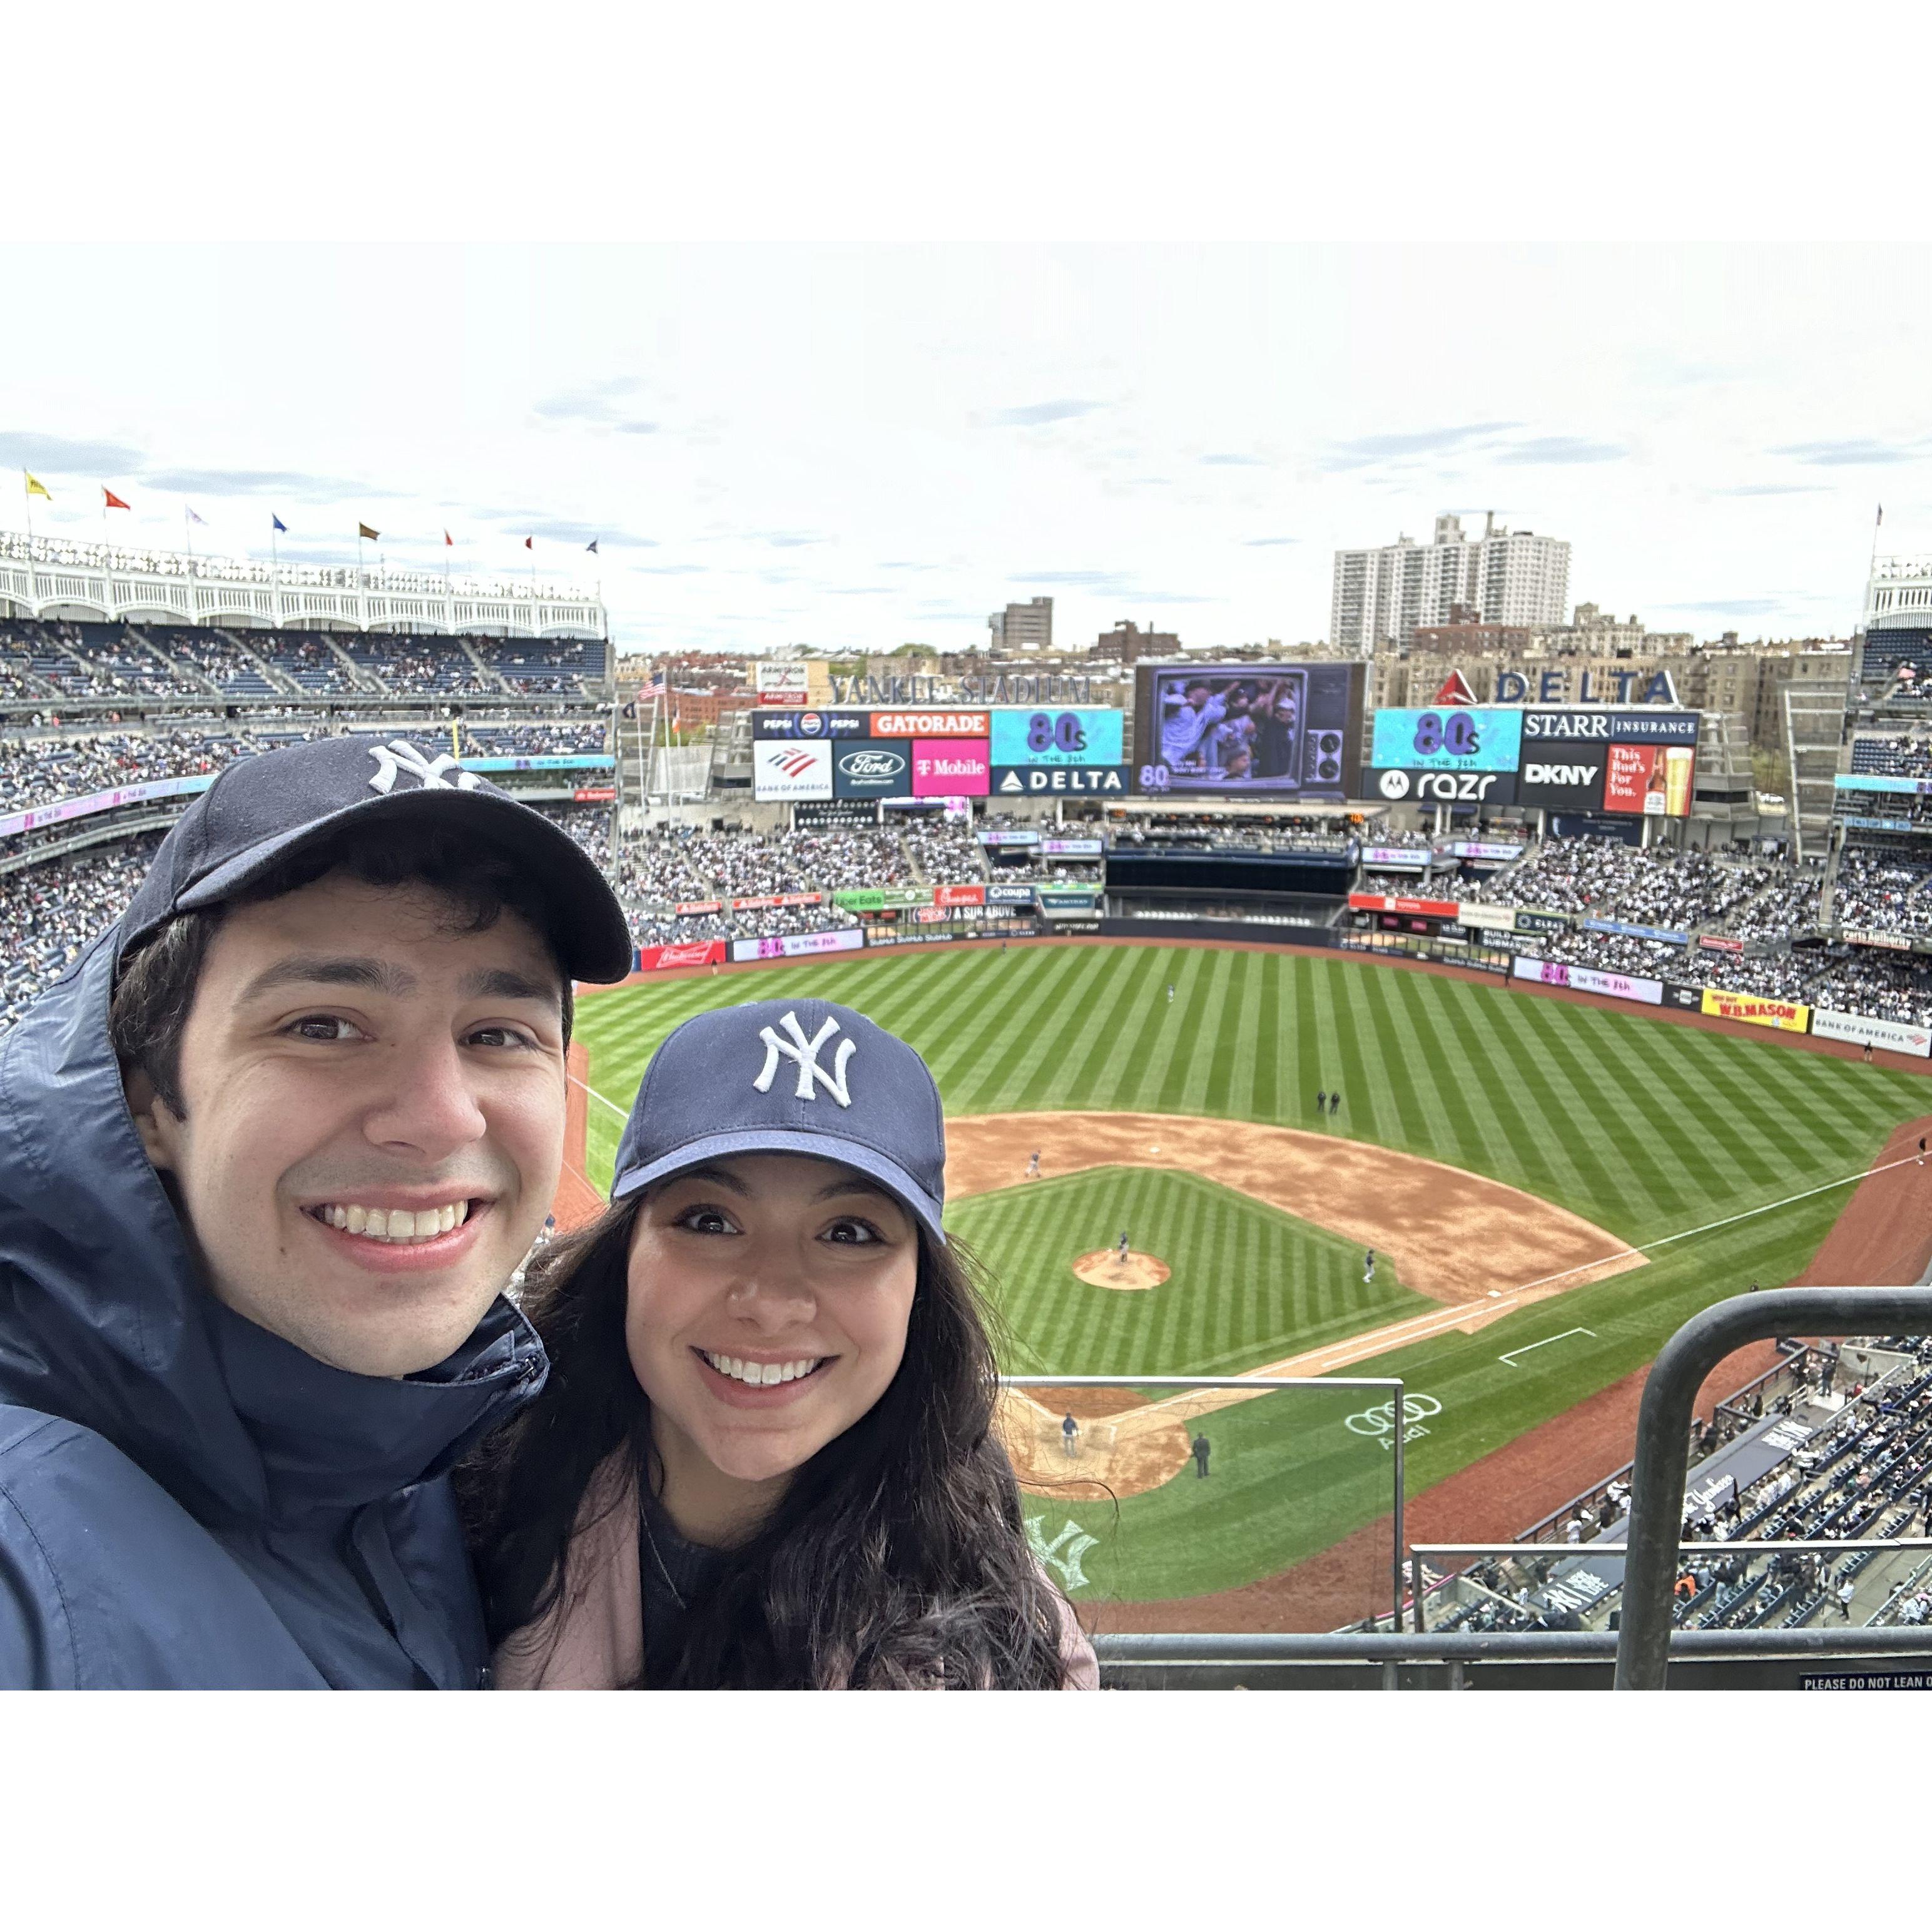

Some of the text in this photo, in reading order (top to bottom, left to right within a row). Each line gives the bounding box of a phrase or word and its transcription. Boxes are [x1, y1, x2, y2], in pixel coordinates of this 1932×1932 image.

[960, 674, 1091, 704] STADIUM
[1496, 670, 1678, 704] DELTA
[763, 719, 793, 730] PEPSI
[830, 719, 860, 730] PEPSI
[877, 714, 985, 733] GATORADE
[1524, 714, 1696, 737] STARR INSURANCE
[1612, 748, 1640, 760] This
[850, 754, 894, 773] Ford
[933, 759, 985, 775] Mobile
[1611, 759, 1645, 773] Bud's
[1030, 770, 1122, 790] DELTA
[1525, 763, 1599, 786] DKNY
[1610, 771, 1633, 784] For
[1417, 773, 1497, 801] razr
[859, 895, 882, 905] Eats
[1003, 888, 1031, 899] coupa
[953, 908, 962, 919] A
[1816, 1018, 1904, 1042] BANK OF AMERICA
[753, 1010, 857, 1108] NY
[1804, 1678, 1846, 1690] PLEASE
[1849, 1677, 1864, 1689] DO
[1868, 1677, 1891, 1689] NOT
[1894, 1675, 1923, 1688] LEAN
